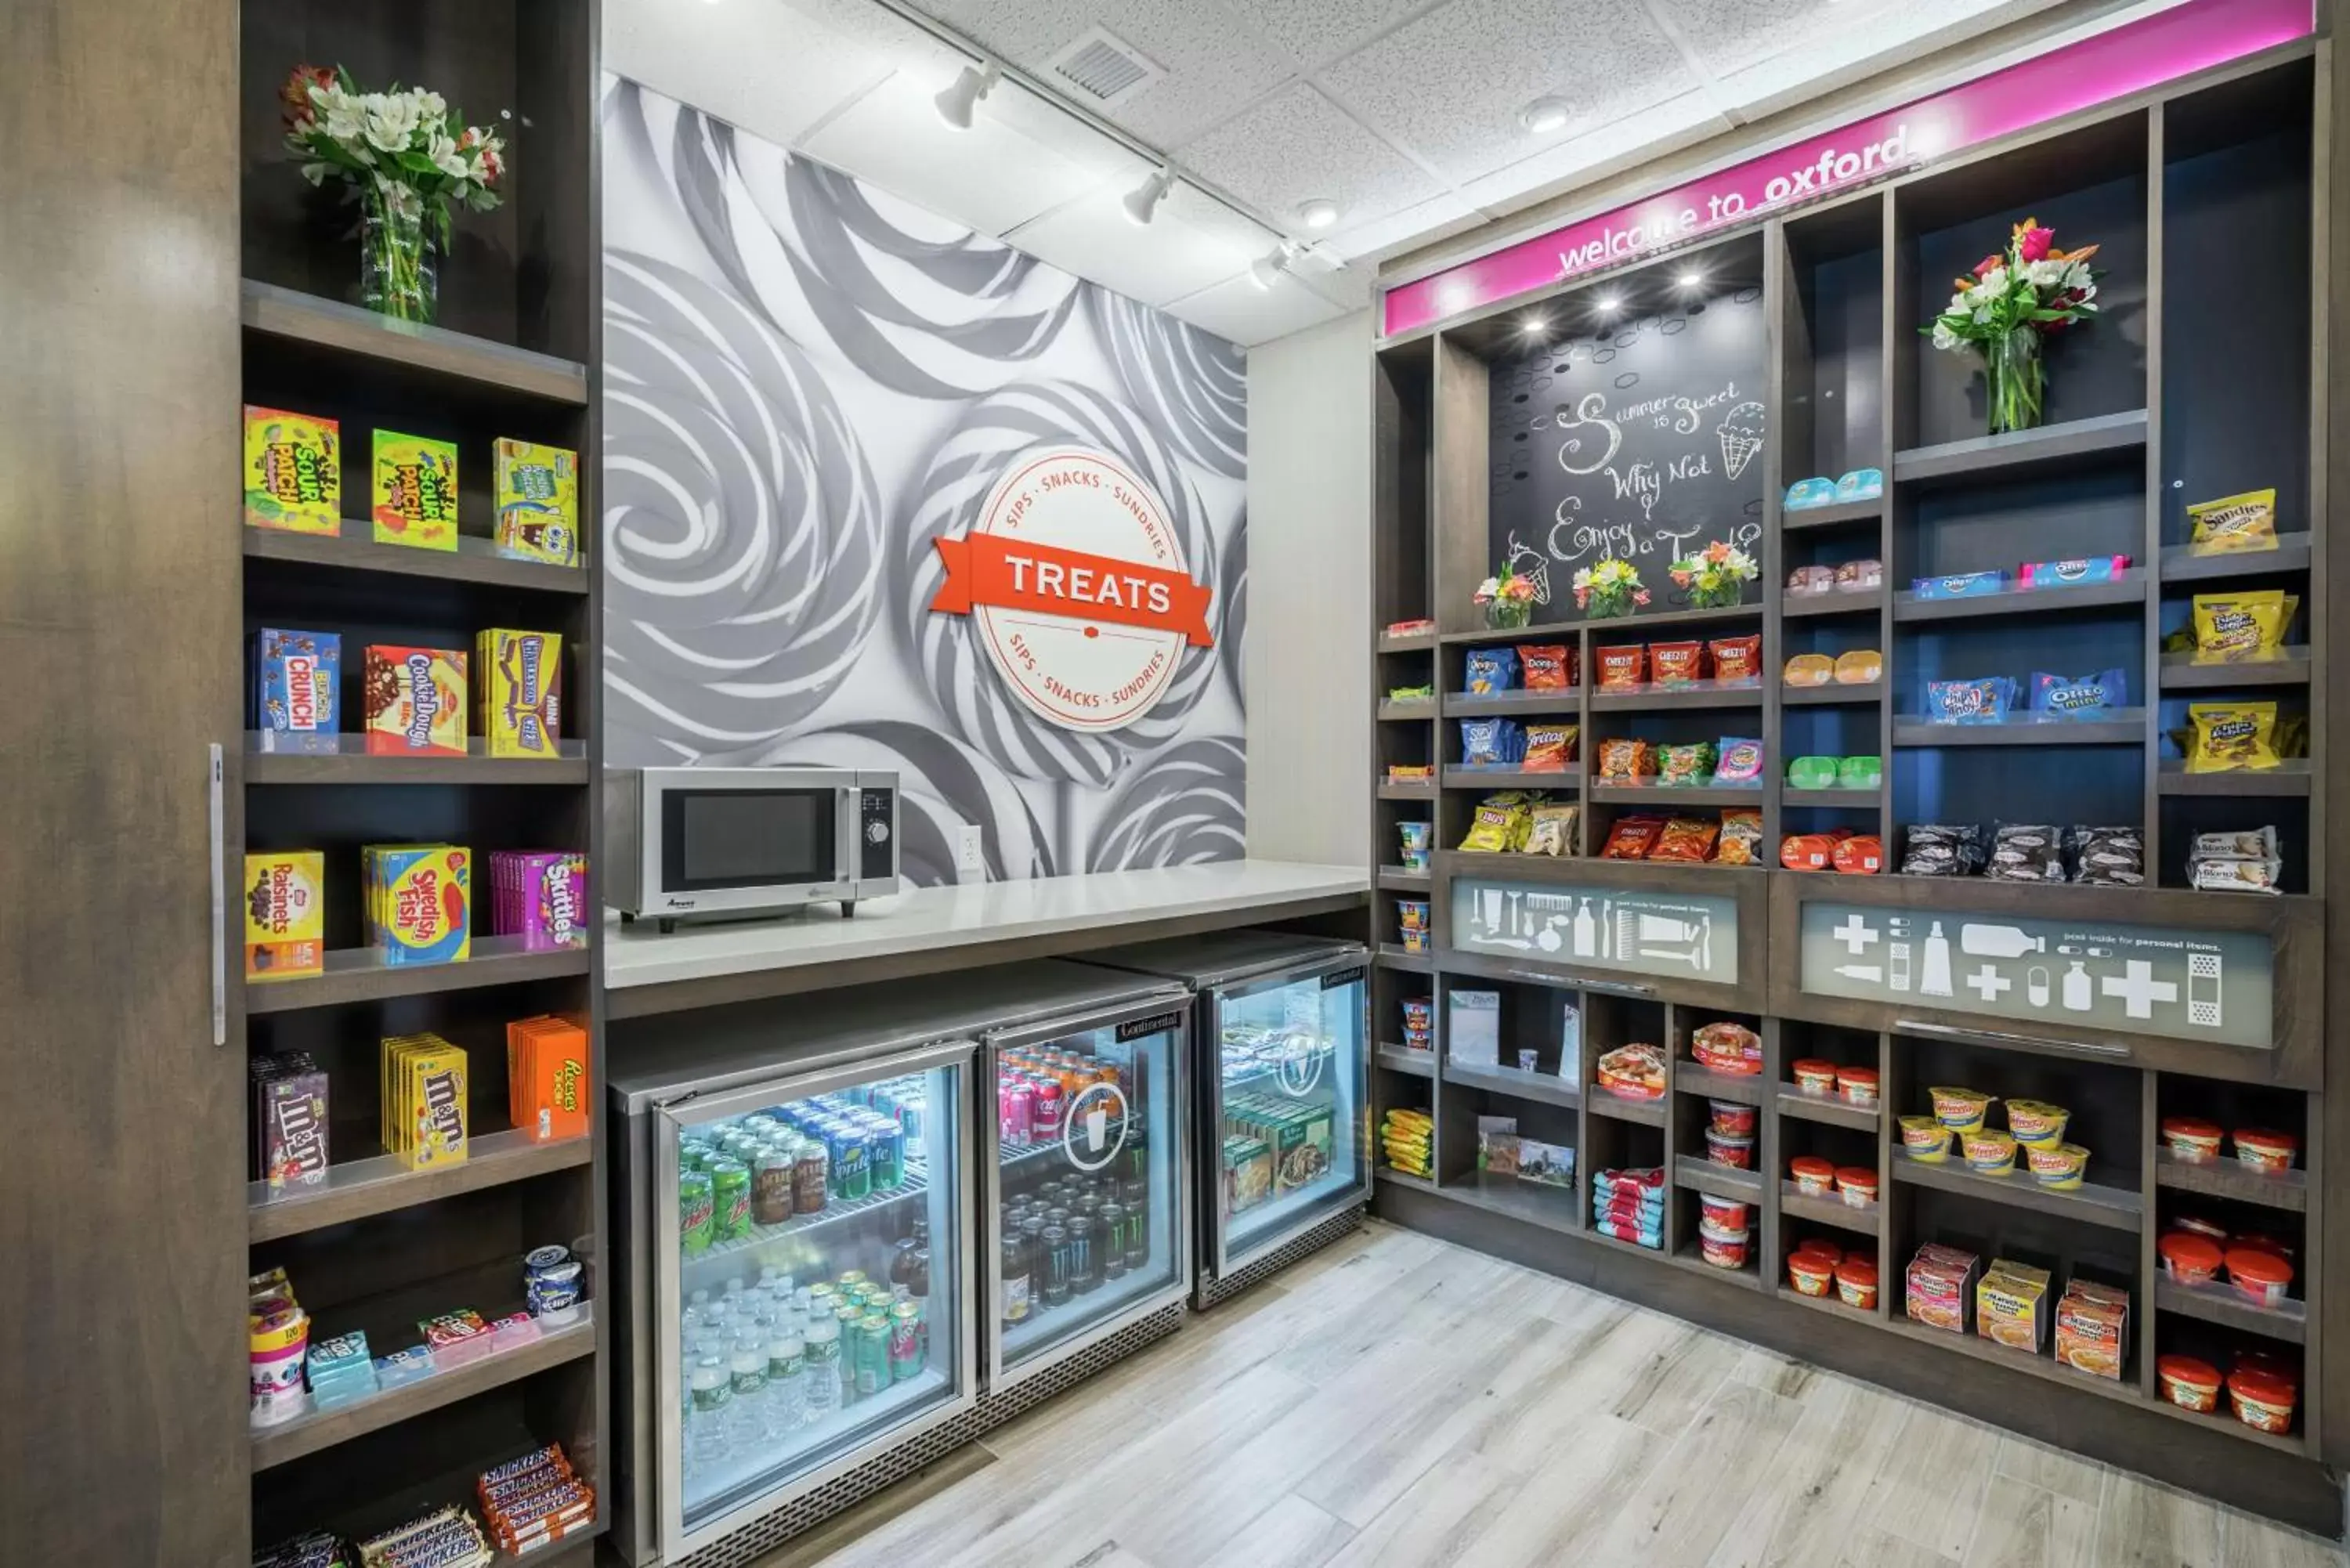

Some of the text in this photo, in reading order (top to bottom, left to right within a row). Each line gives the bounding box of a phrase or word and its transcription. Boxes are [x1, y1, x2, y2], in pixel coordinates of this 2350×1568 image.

[1559, 125, 1907, 271] welcome to oxford
[1556, 393, 1677, 475] Summer
[277, 444, 299, 503] PATCH
[295, 446, 320, 502] SOUR
[402, 465, 421, 520] PATCH
[419, 468, 439, 519] SOUR
[1604, 454, 1712, 521] Why Not
[1006, 470, 1166, 560] SIPS SNACKS SUNDRIES
[1548, 496, 1636, 562] Enjoy
[1005, 554, 1171, 613] TREATS
[289, 658, 313, 728] CRUNCH
[1009, 634, 1165, 708] SIPS SNACKS SUNDRIES
[273, 864, 294, 934] Raisinets
[397, 887, 421, 929] Fish
[415, 868, 440, 941] Swedish
[548, 863, 571, 945] Skittles
[2135, 939, 2183, 949] personal
[834, 1154, 870, 1180] Sprite
[485, 1447, 550, 1483] SNICKERS
[406, 1537, 479, 1568] NICKERS
